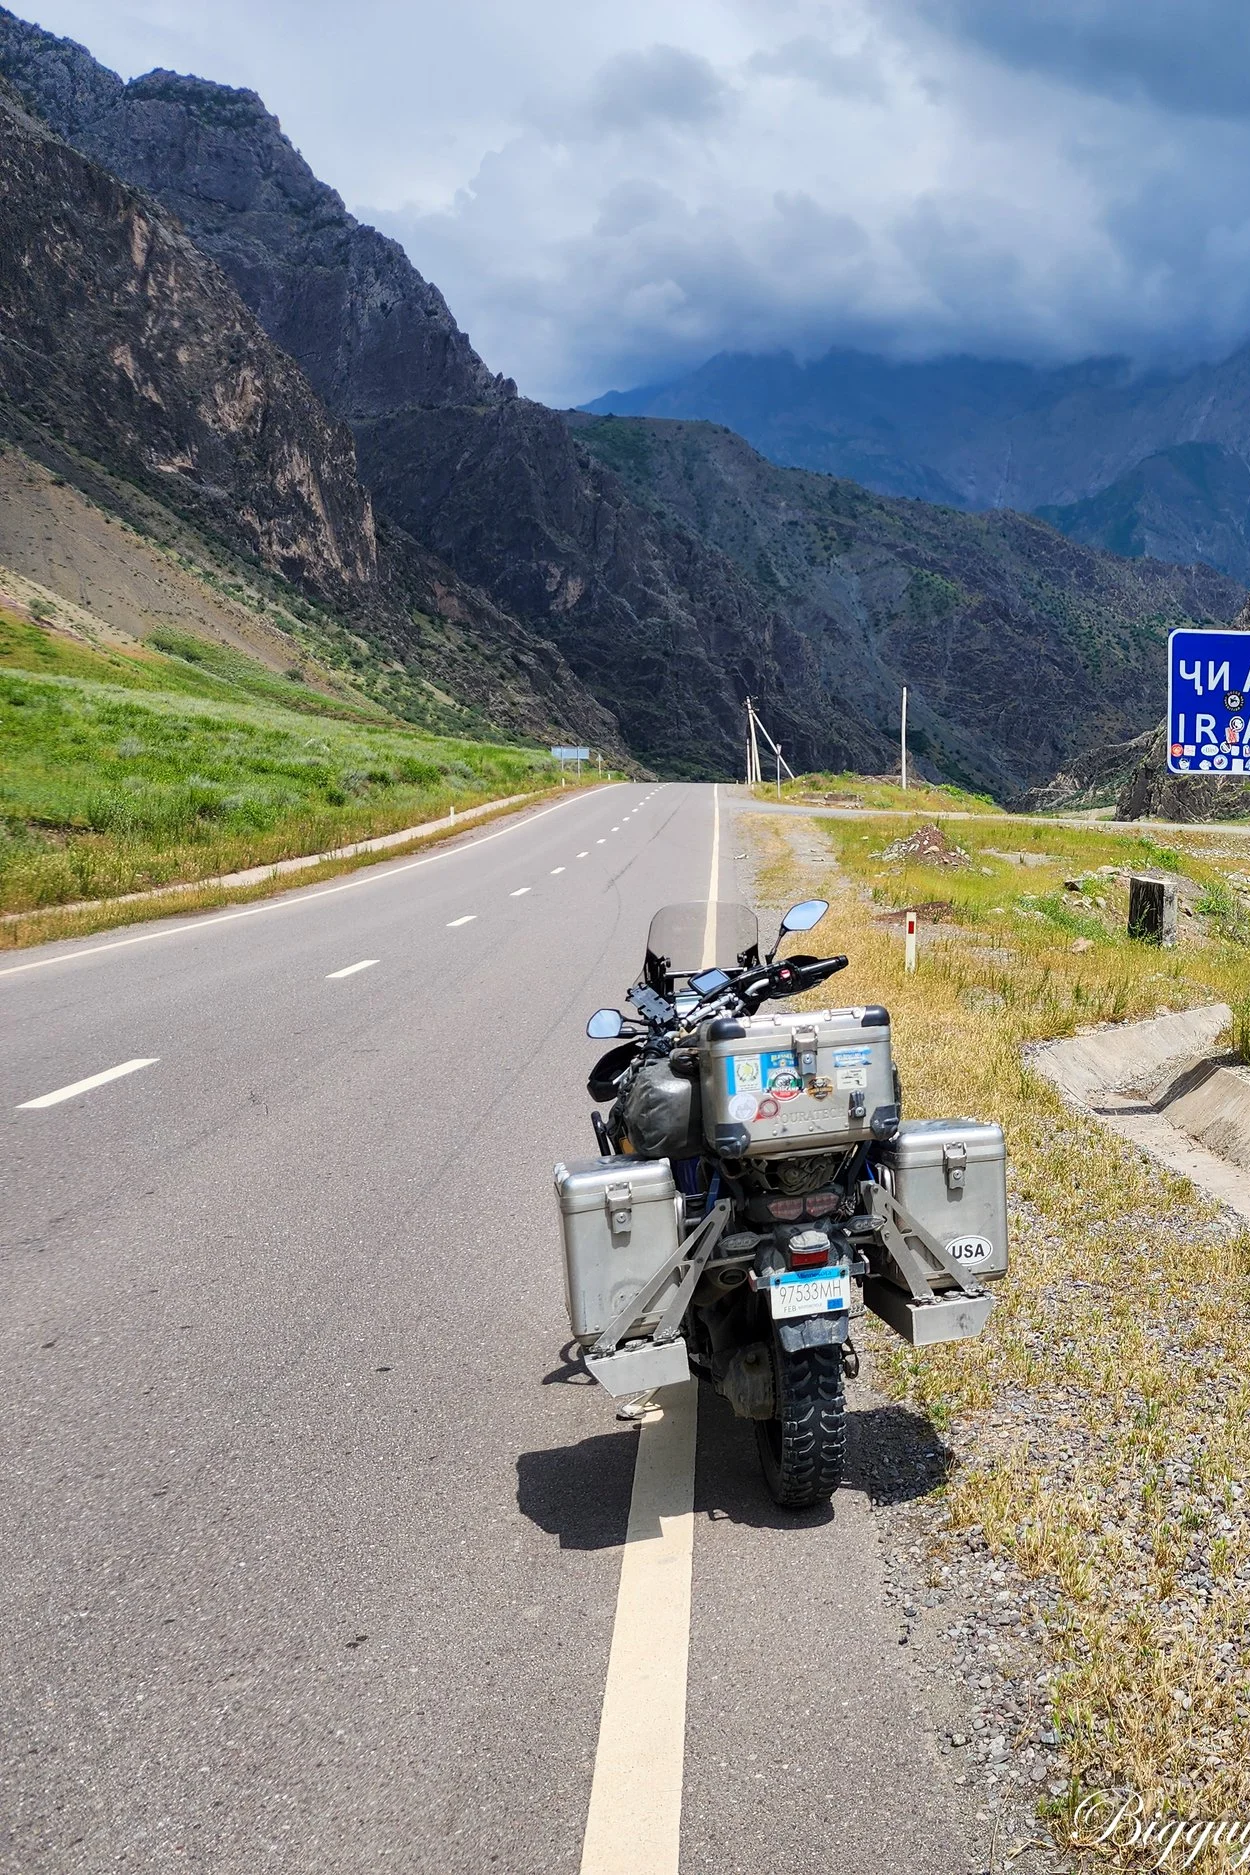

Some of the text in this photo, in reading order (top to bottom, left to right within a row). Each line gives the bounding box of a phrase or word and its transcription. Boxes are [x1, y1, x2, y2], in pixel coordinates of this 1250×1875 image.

[774, 1107, 847, 1126] TOURATECH
[952, 1243, 985, 1259] USA
[779, 1279, 842, 1305] 97533MH
[783, 1305, 797, 1314] FEB
